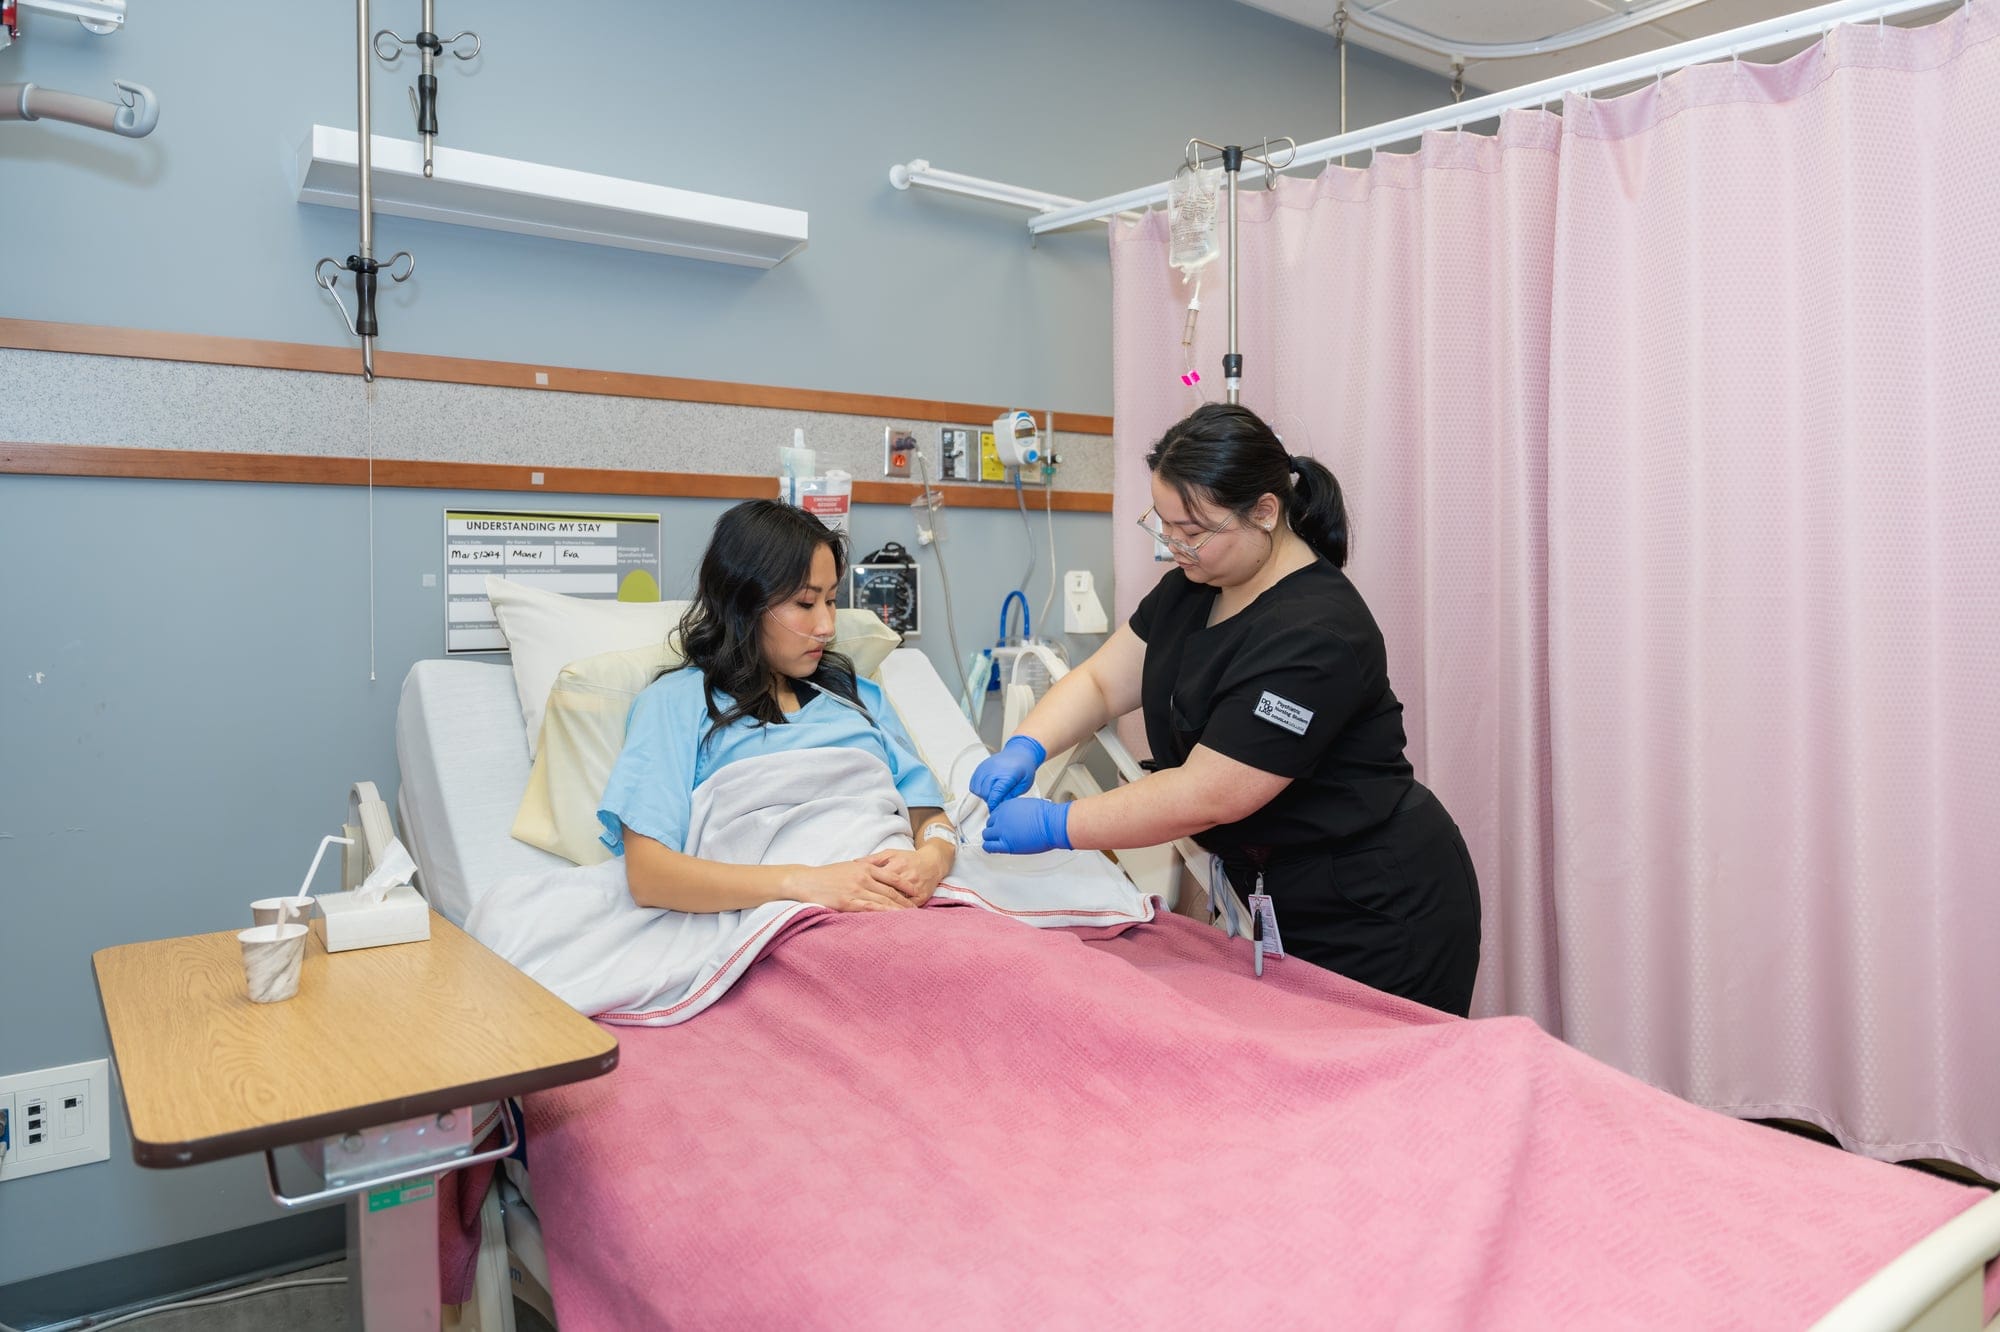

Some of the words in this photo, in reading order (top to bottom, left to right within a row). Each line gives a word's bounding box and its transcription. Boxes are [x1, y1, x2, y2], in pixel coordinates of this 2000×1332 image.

[466, 521, 555, 532] UNDERSTANDING
[559, 523, 574, 532] MY
[577, 523, 601, 532] STAY
[563, 549, 580, 559] Eva
